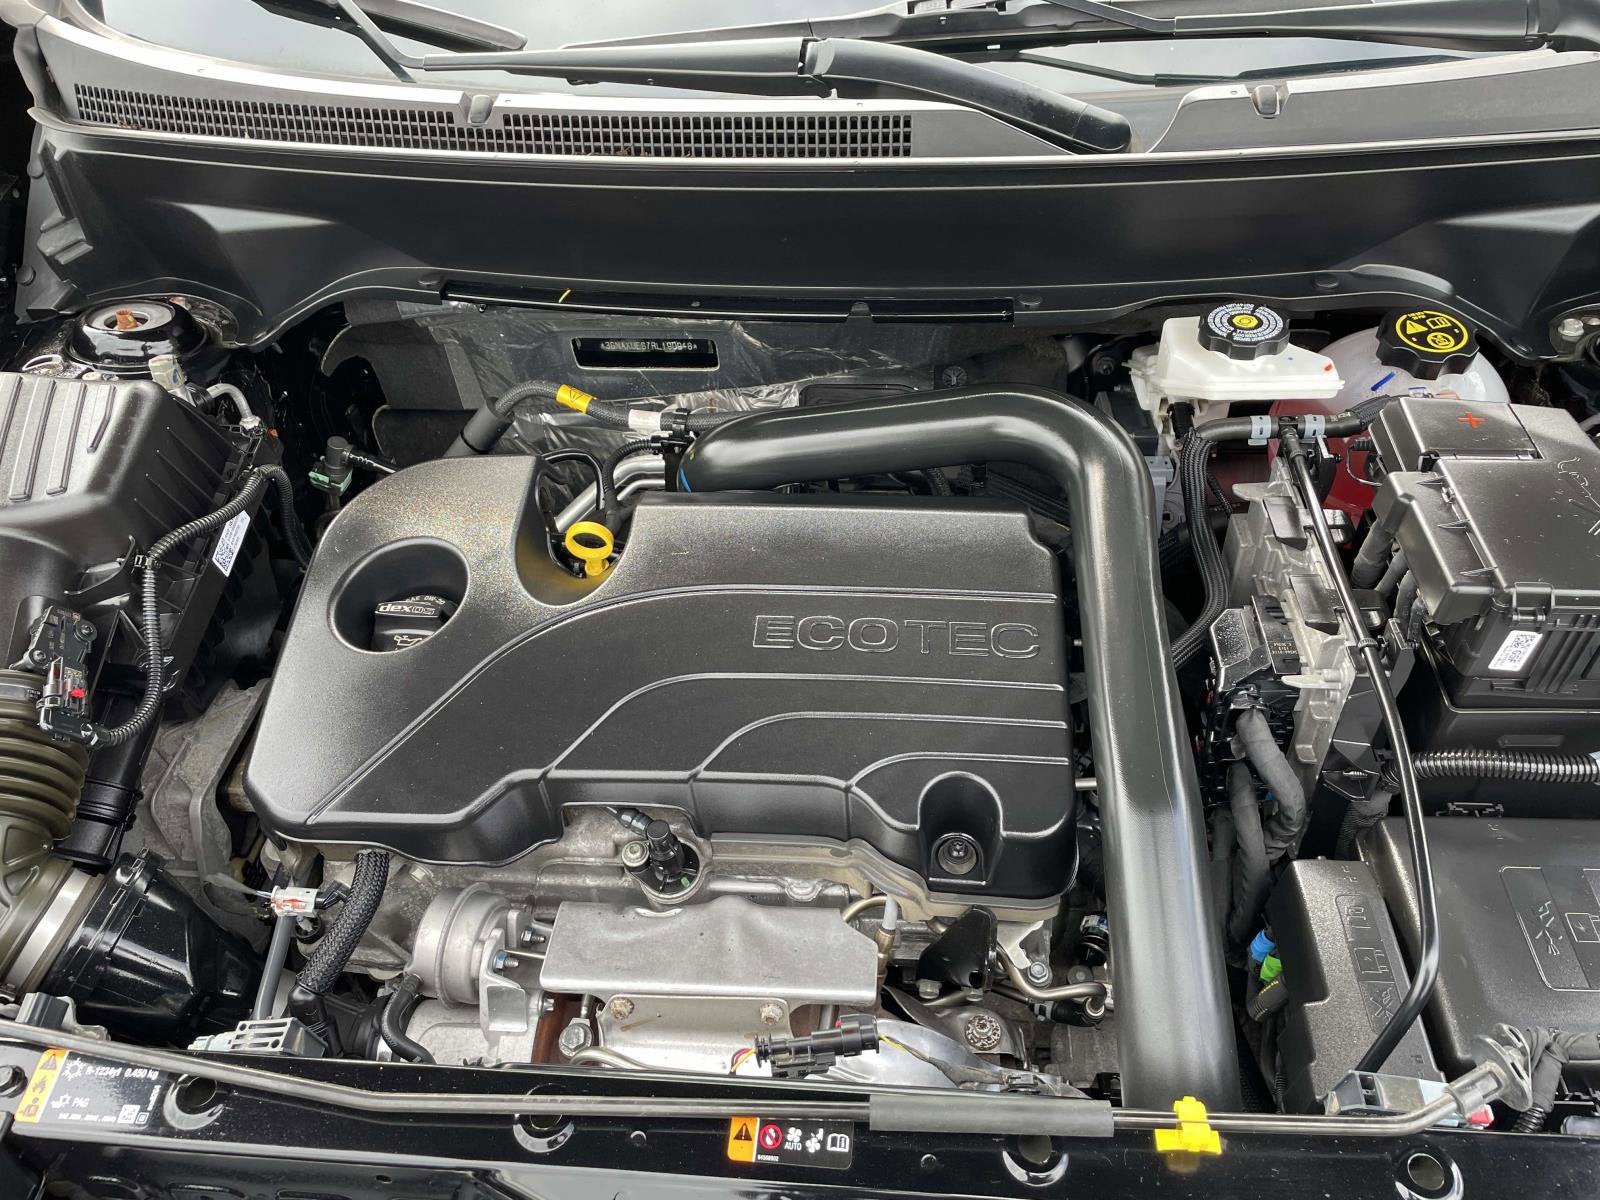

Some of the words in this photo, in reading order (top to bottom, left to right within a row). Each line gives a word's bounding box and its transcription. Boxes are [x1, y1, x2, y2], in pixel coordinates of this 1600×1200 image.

[378, 603, 436, 615] dexos
[753, 615, 1040, 658] ECOTEC
[146, 1069, 160, 1080] kg
[71, 1097, 91, 1108] PAG
[784, 1141, 803, 1151] AUTO
